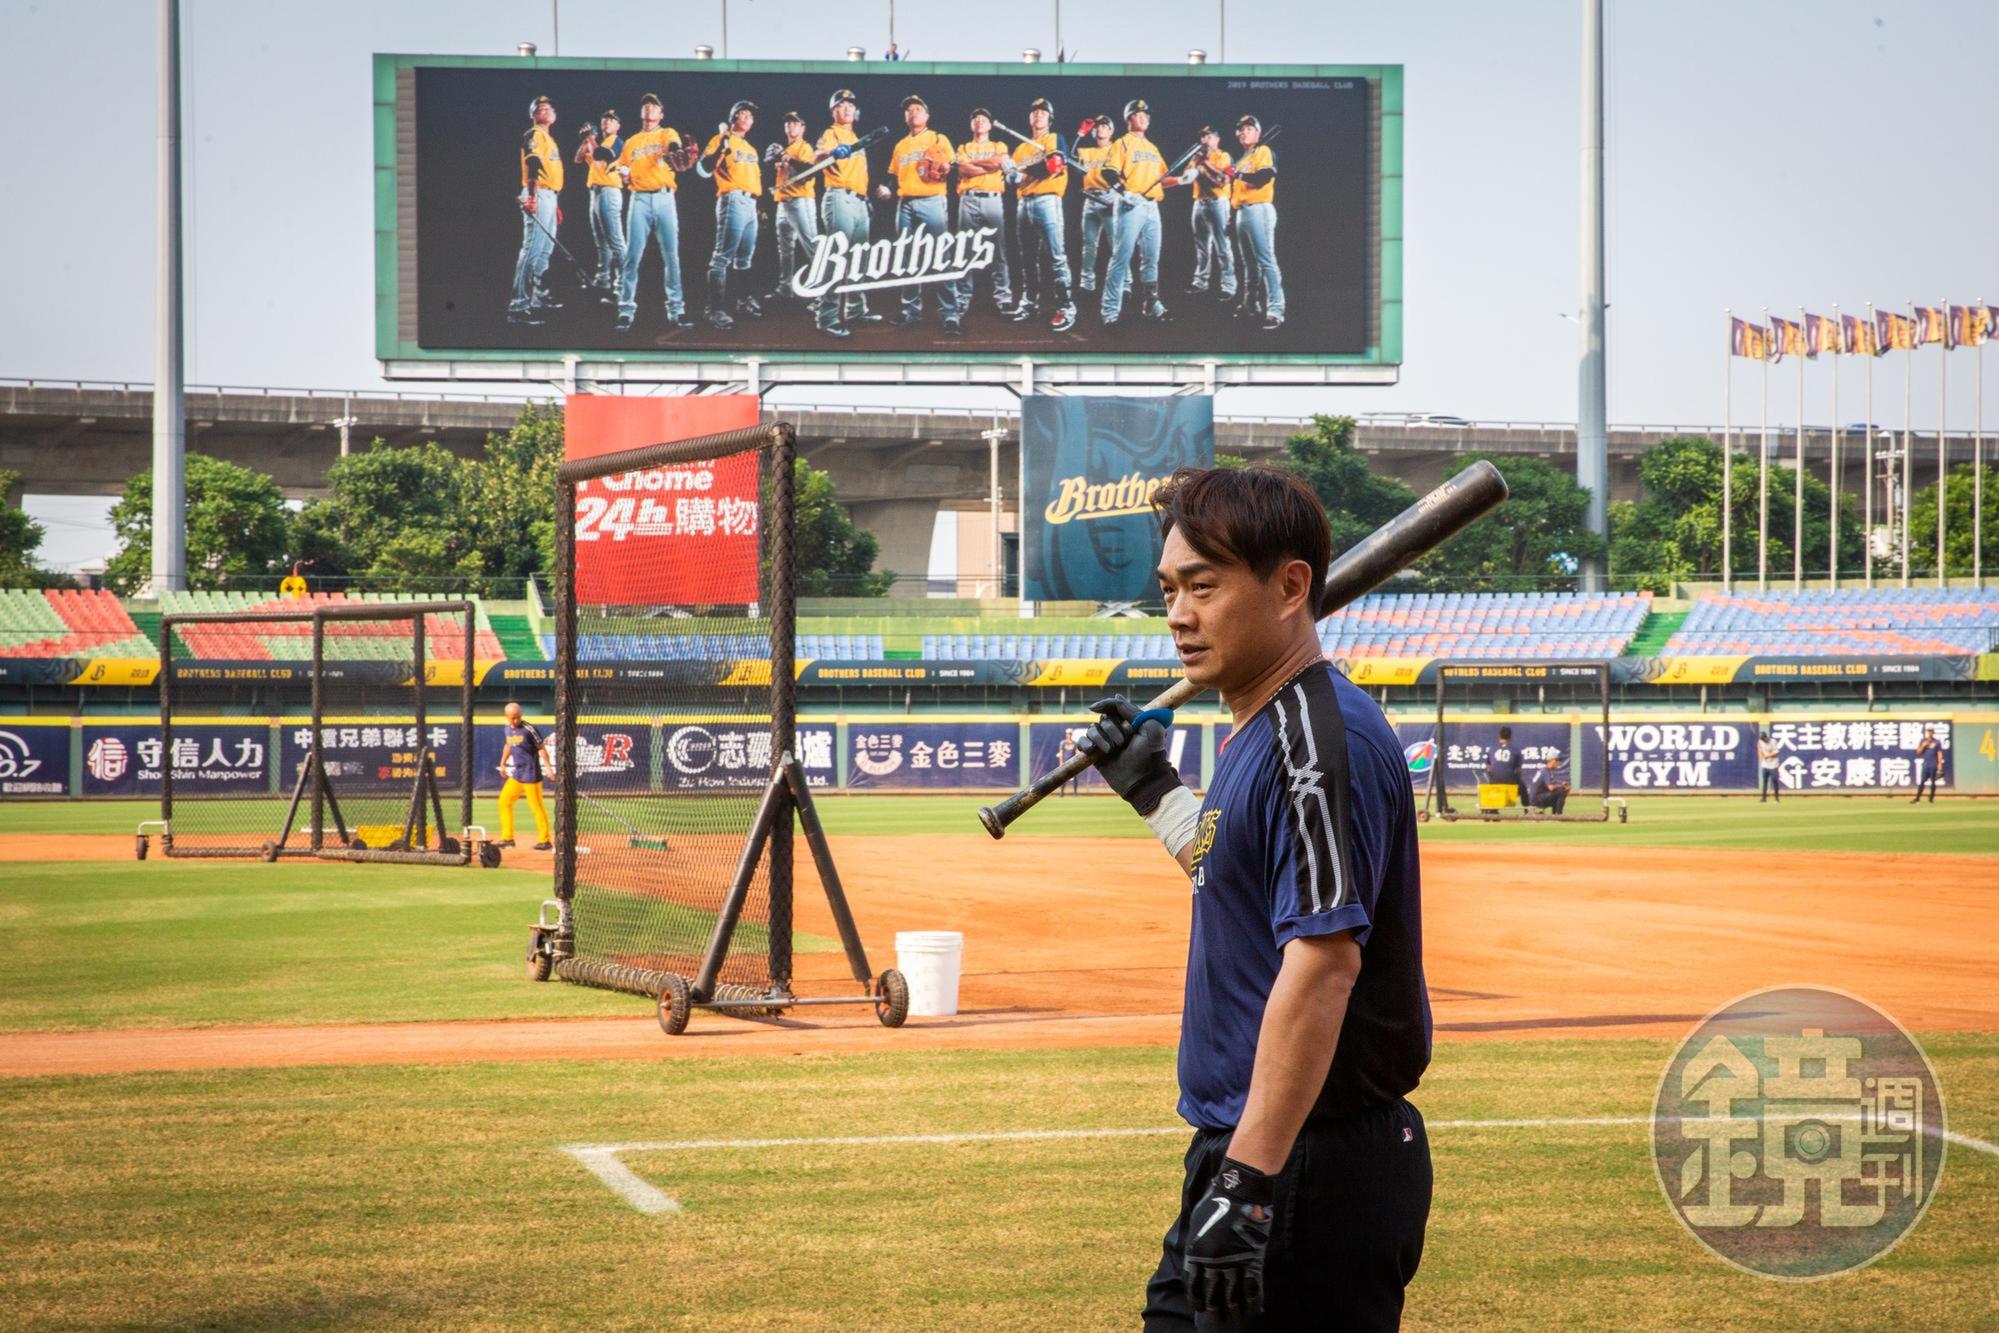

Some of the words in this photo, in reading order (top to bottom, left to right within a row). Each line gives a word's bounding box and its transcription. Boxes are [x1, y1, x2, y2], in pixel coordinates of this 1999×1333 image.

[1250, 81, 1289, 89] BROTHERS
[1292, 81, 1330, 89] BASEBALL
[1334, 81, 1354, 89] CLUB
[792, 222, 998, 297] Brothers
[504, 669, 547, 679] BROTHERS
[818, 669, 860, 679] BROTHERS
[862, 669, 903, 679] BASEBALL
[905, 669, 926, 679] CLUB
[1127, 668, 1169, 679] BROTHERS
[1755, 664, 1799, 675] BROTHERS
[1801, 664, 1844, 675] BASEBALL
[1845, 664, 1868, 675] CLUB
[855, 734, 903, 749] 金色三麥
[1595, 725, 1740, 751] WORLD
[137, 737, 263, 769] 守信人力
[909, 740, 1012, 769] 金色三麥
[137, 769, 163, 780] Sho
[198, 769, 263, 781] Manpower
[1622, 760, 1711, 787] GYM
